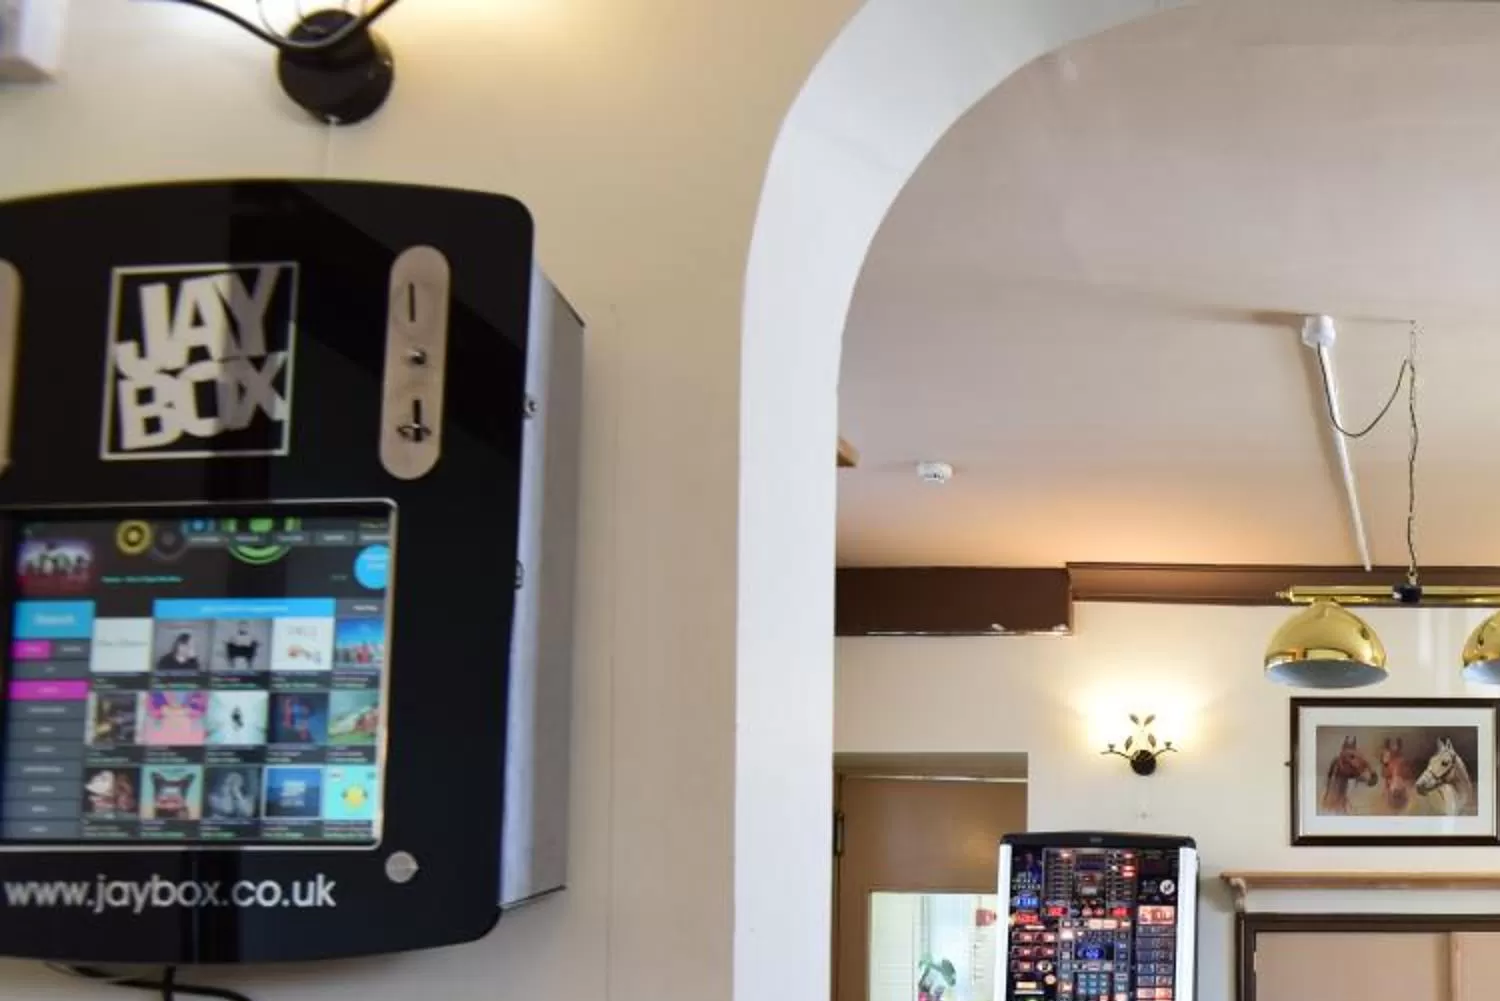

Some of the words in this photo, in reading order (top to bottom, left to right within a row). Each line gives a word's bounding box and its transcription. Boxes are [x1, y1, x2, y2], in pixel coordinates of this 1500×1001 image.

[112, 264, 282, 372] JAY
[116, 350, 291, 451] BOX
[4, 873, 338, 914] www.jaybox.co.uk
